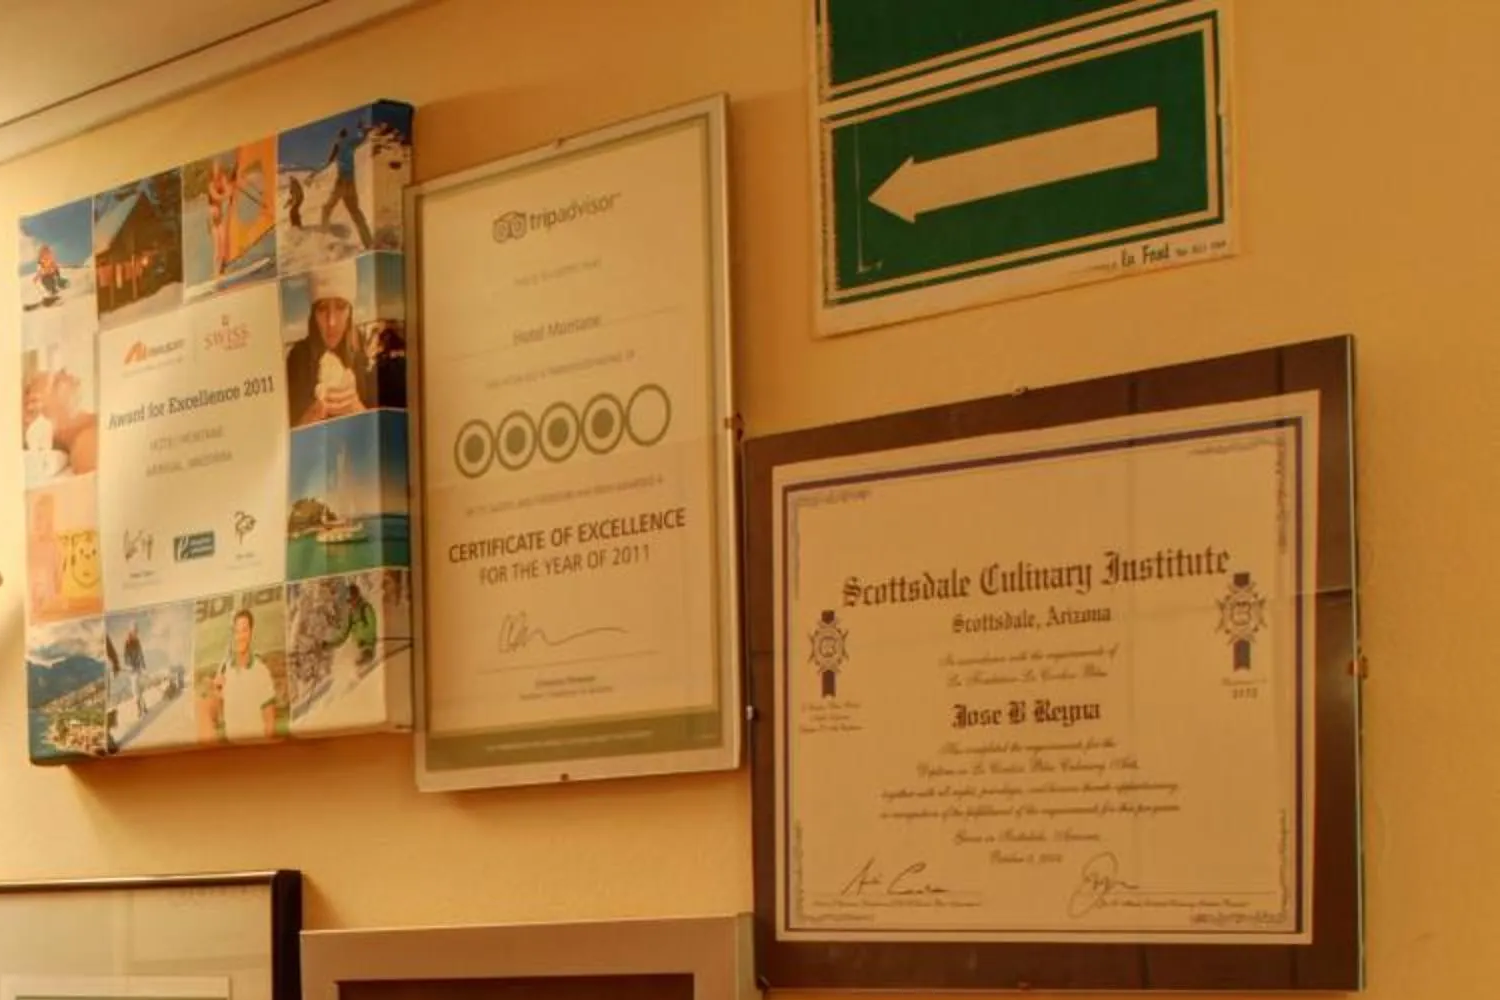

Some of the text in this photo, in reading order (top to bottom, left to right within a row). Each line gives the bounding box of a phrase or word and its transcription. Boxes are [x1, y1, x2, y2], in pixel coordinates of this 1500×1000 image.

[529, 193, 616, 229] tripadvisor
[108, 375, 275, 430] Award for Excellence 2011
[449, 507, 687, 563] CERTIFICATE OF EXCELLENCE
[479, 544, 650, 586] FOR THE YEAR OF 2011
[842, 544, 1231, 607] Scottsdale Culinary Institute
[1046, 604, 1112, 628] Arizona
[952, 699, 1101, 729] Jose B Reyna
